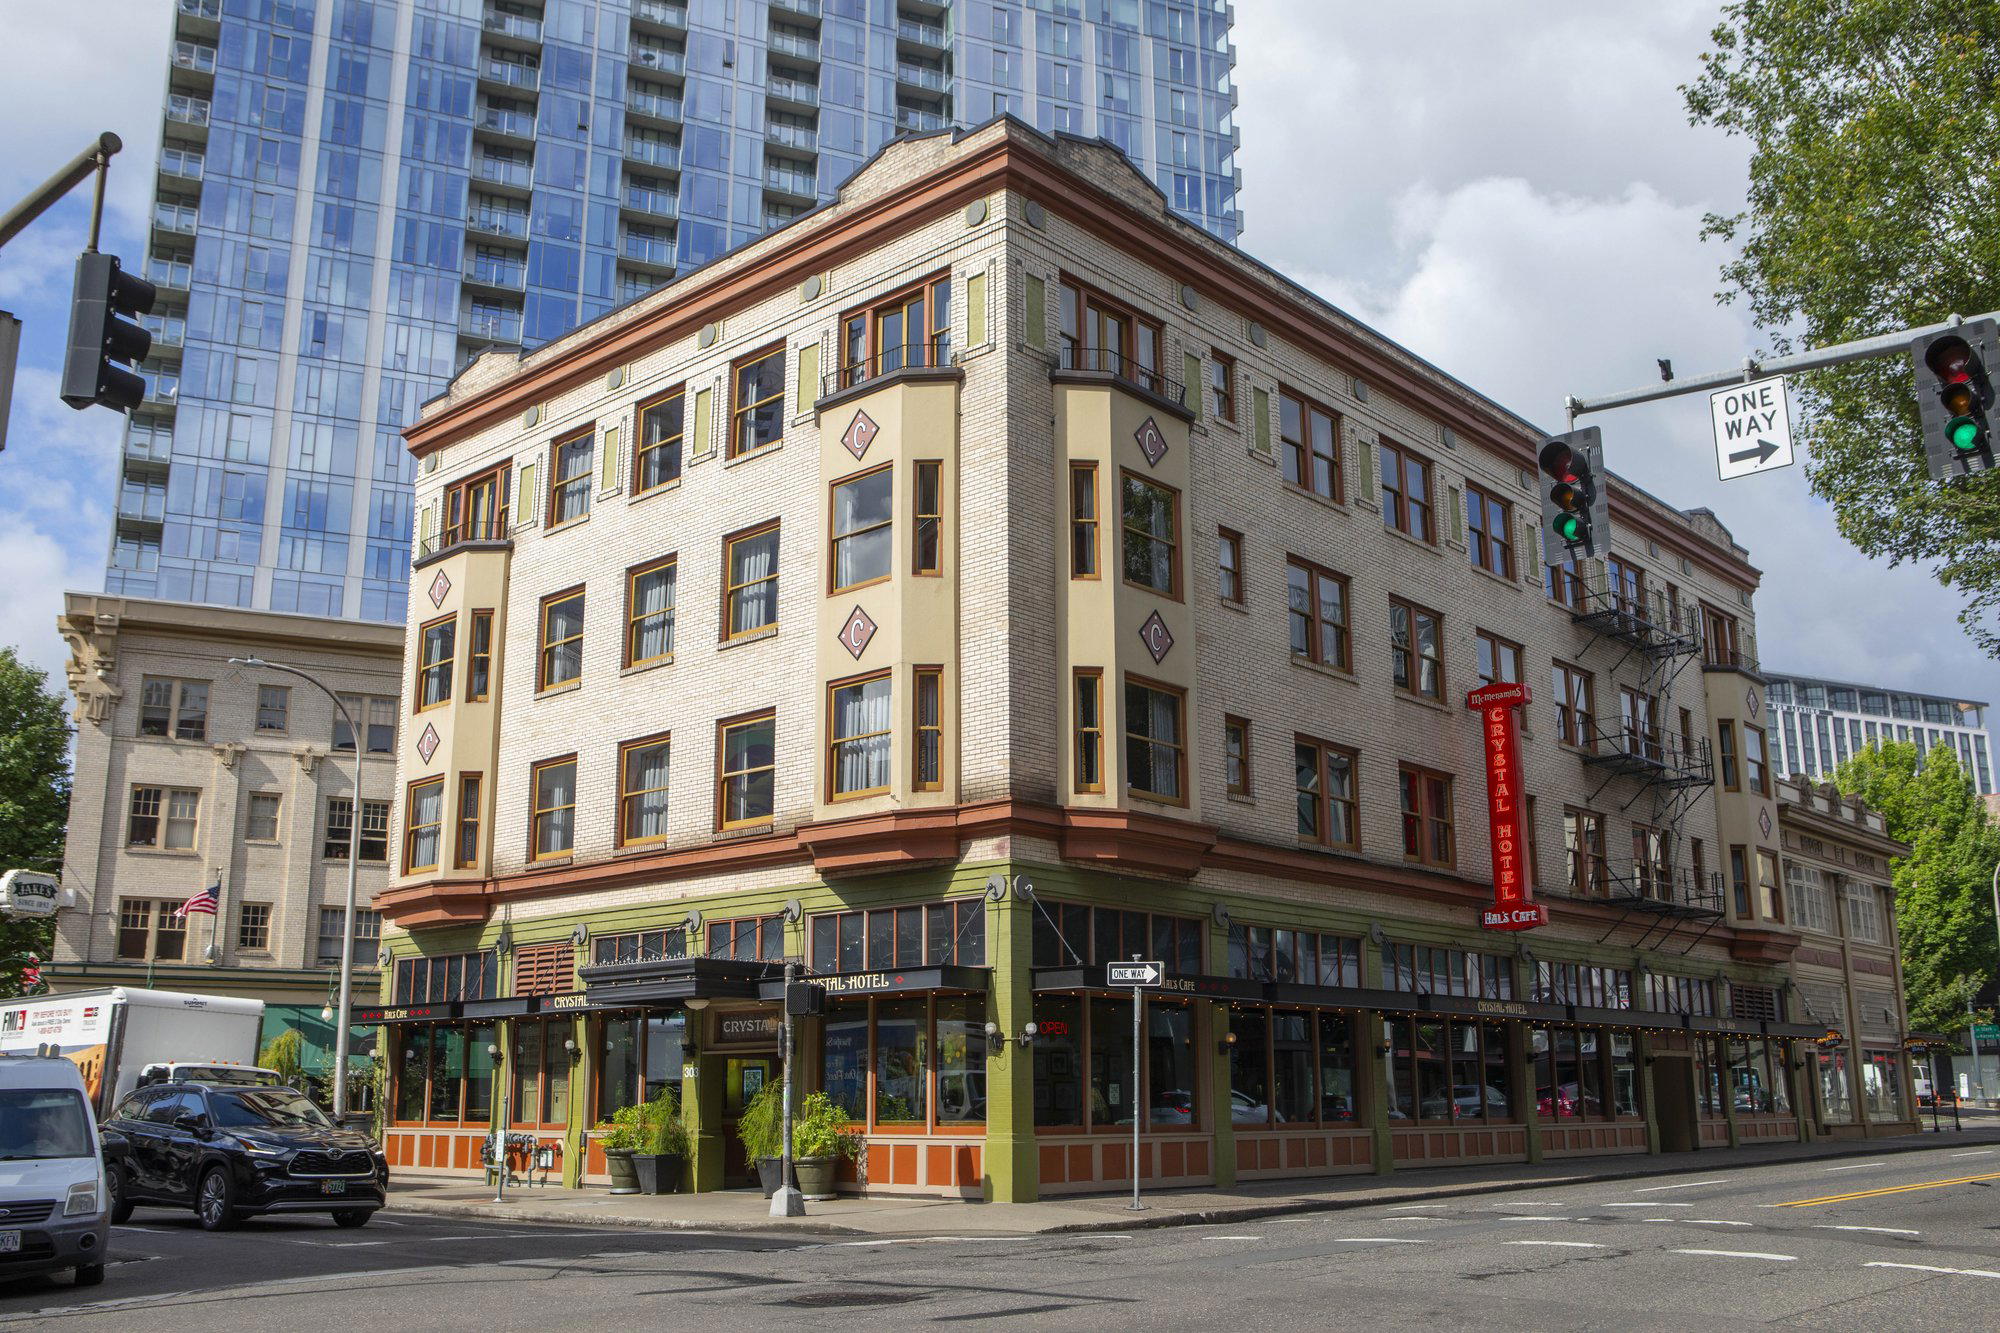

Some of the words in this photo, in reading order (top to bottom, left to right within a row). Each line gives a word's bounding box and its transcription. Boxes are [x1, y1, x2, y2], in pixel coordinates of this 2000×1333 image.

[1725, 386, 1774, 415] ONE
[853, 421, 866, 449] C
[1725, 409, 1777, 440] WAY
[1145, 429, 1157, 455] C
[851, 619, 865, 648] C
[1150, 623, 1162, 651] C
[1471, 687, 1521, 705] McMenamins
[1488, 707, 1510, 812] CRYSTAL
[1497, 825, 1515, 900] HOTEL
[846, 974, 889, 989] HOTEL
[1113, 969, 1128, 978] ONE
[1131, 969, 1146, 978] WAY
[554, 994, 589, 1009] CRYSTAL
[1477, 1000, 1505, 1013] CRYSTAL
[1504, 1002, 1528, 1015] HOTEL
[723, 1019, 777, 1033] CRYSTAL
[1039, 1020, 1068, 1035] OPEN
[684, 1066, 699, 1078] 303
